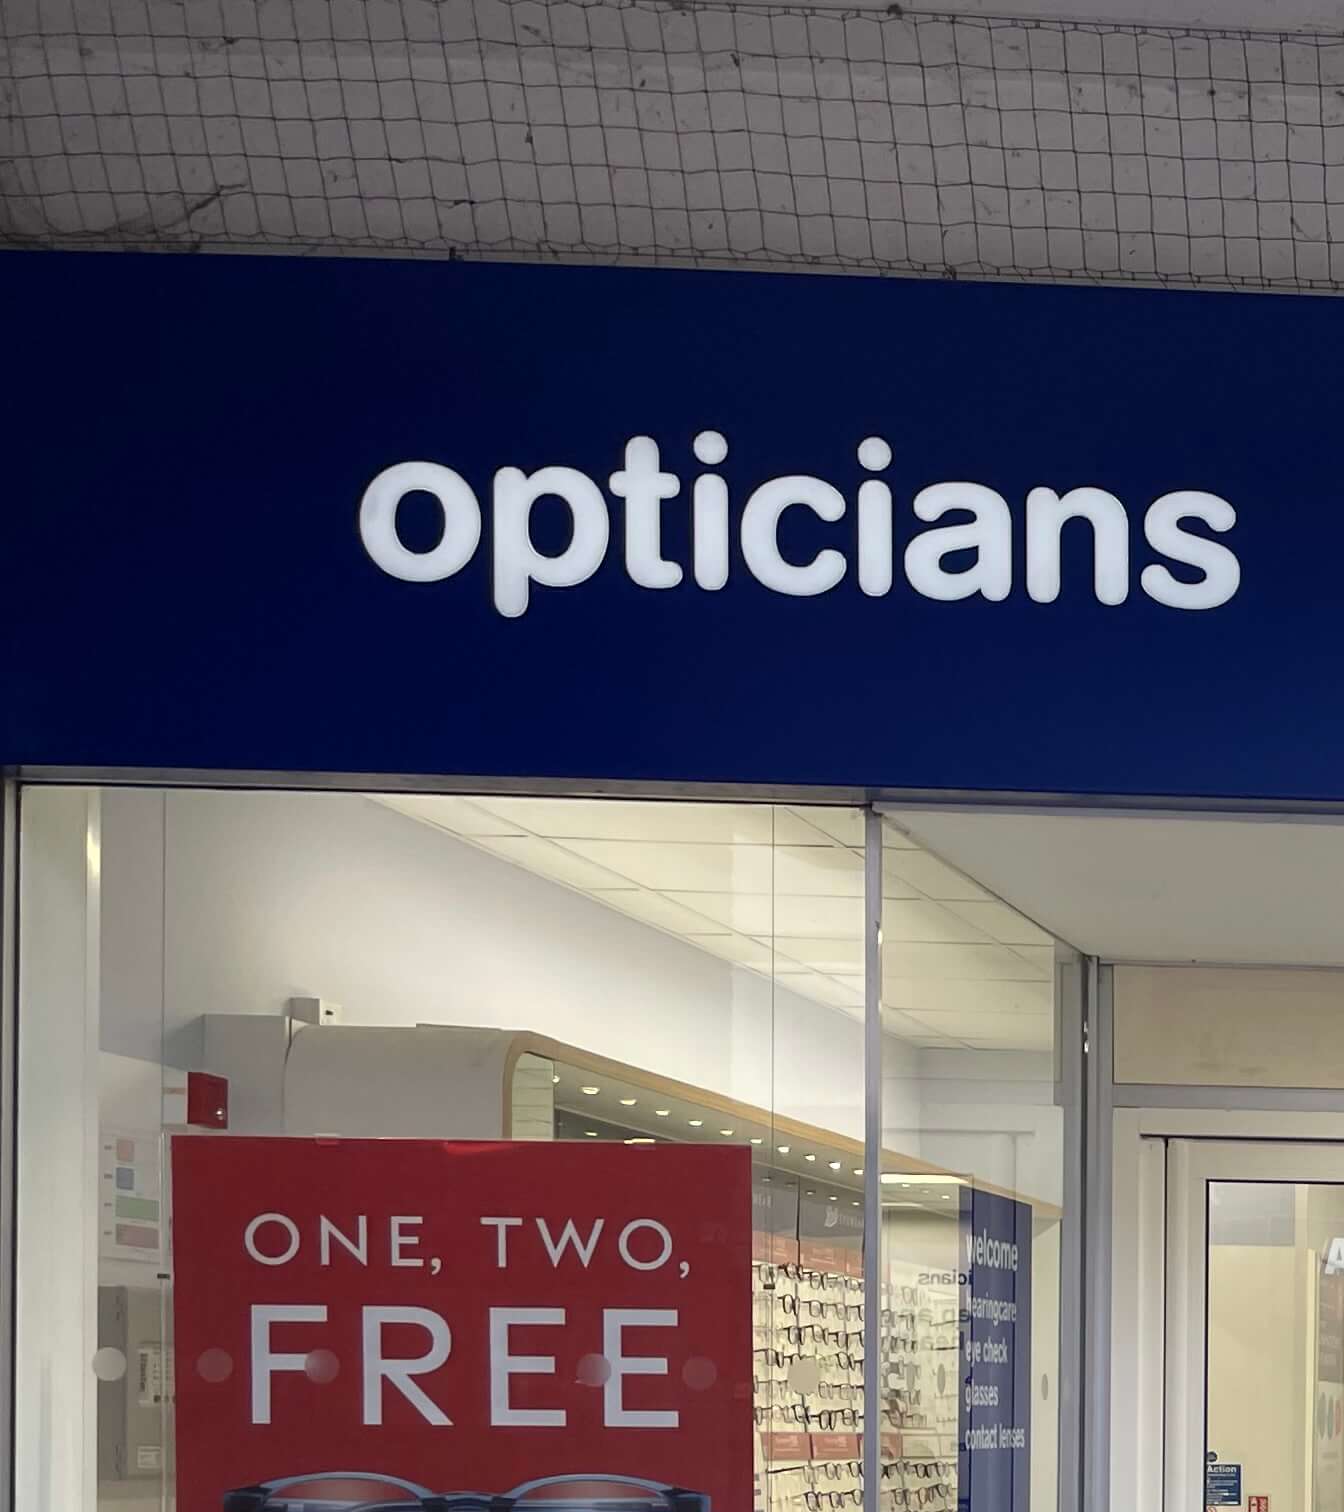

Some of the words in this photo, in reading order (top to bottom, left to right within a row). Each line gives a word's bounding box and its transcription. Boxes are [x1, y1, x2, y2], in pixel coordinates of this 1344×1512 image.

[359, 431, 1241, 617] opticians
[244, 1213, 442, 1275] ONE,
[480, 1217, 690, 1279] TWO,
[966, 1230, 1018, 1271] welcome
[966, 1292, 1017, 1326] hearingcare
[251, 1304, 679, 1428] FREE
[965, 1341, 982, 1369] eye
[983, 1337, 1008, 1364] check
[965, 1377, 998, 1412] glasses
[965, 1425, 998, 1450] contact
[999, 1424, 1025, 1449] lenses
